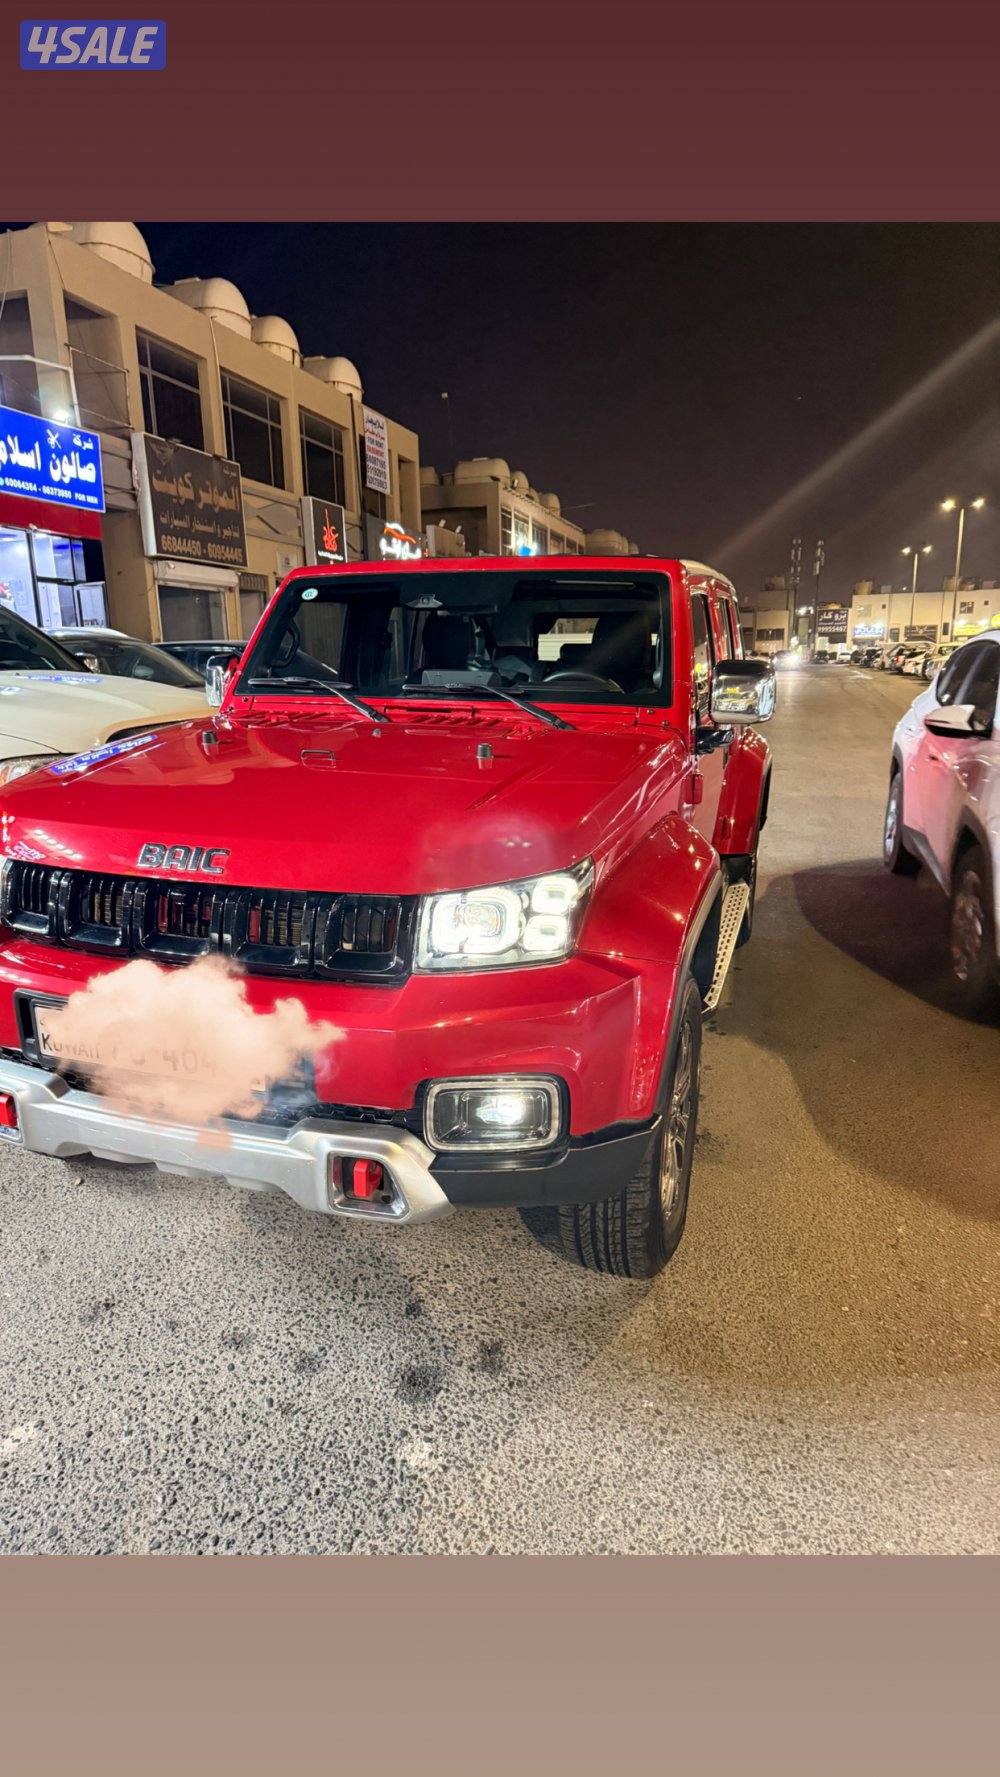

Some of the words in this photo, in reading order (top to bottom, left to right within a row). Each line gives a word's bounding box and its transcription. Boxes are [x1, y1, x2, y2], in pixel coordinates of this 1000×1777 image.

[0, 434, 41, 472] اسلام
[73, 433, 94, 450] شركة
[50, 451, 97, 484] صالون
[152, 469, 195, 505] كويت
[161, 534, 202, 556] 66844450
[136, 843, 231, 875] BAIC
